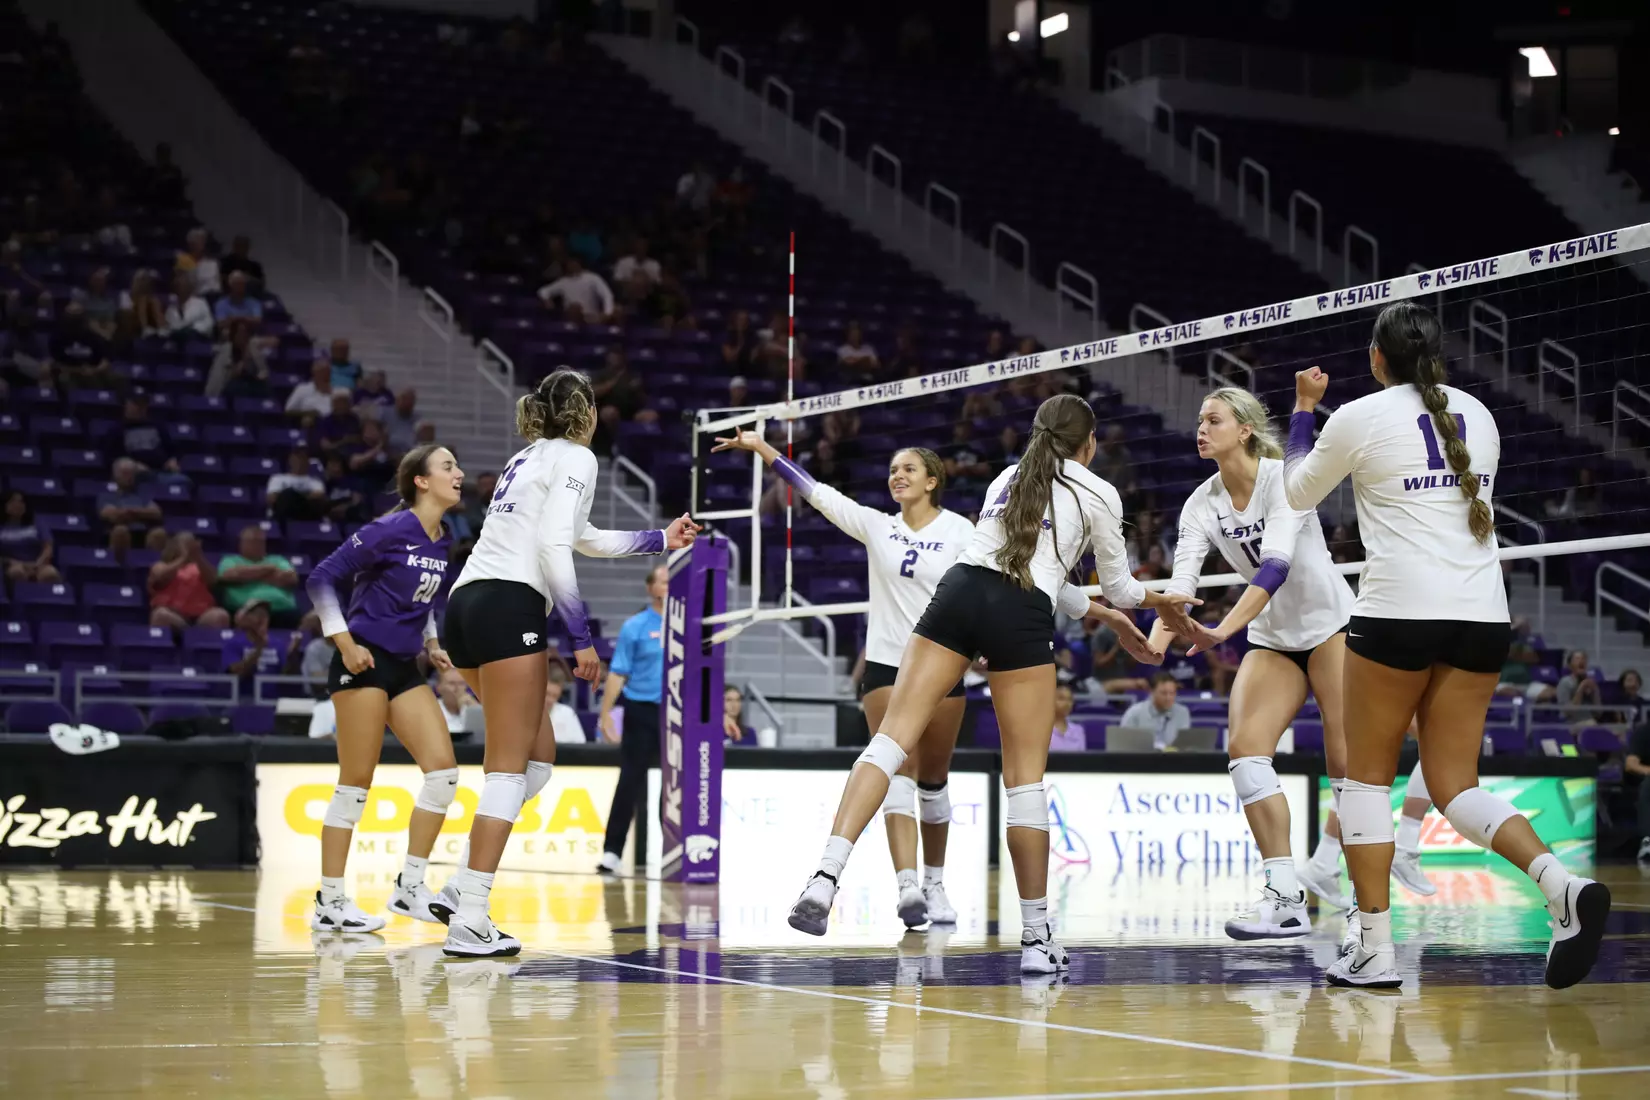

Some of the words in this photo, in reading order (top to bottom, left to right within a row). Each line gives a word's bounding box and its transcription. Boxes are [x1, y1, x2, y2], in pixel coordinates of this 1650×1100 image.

[868, 382, 904, 400] K-STATE
[930, 368, 970, 388] K-STATE
[999, 354, 1041, 376] K-STATE
[1072, 339, 1119, 362] K-STATE
[1152, 322, 1201, 346] K-STATE
[1238, 302, 1293, 328] K-STATE
[1333, 281, 1391, 308] K-STATE
[1435, 257, 1500, 287] K-STATE
[1547, 231, 1619, 264] K-STATE
[1403, 473, 1490, 491] WILDCTS
[1221, 518, 1266, 539] K-STAT
[406, 554, 448, 572] K-STAT
[900, 549, 919, 579] 2
[412, 572, 442, 604] 20
[664, 596, 687, 827] K-STATE
[1108, 783, 1241, 815] Ascensi
[106, 795, 217, 848] Hut
[523, 840, 599, 854] EATS
[1175, 830, 1263, 863] Chris
